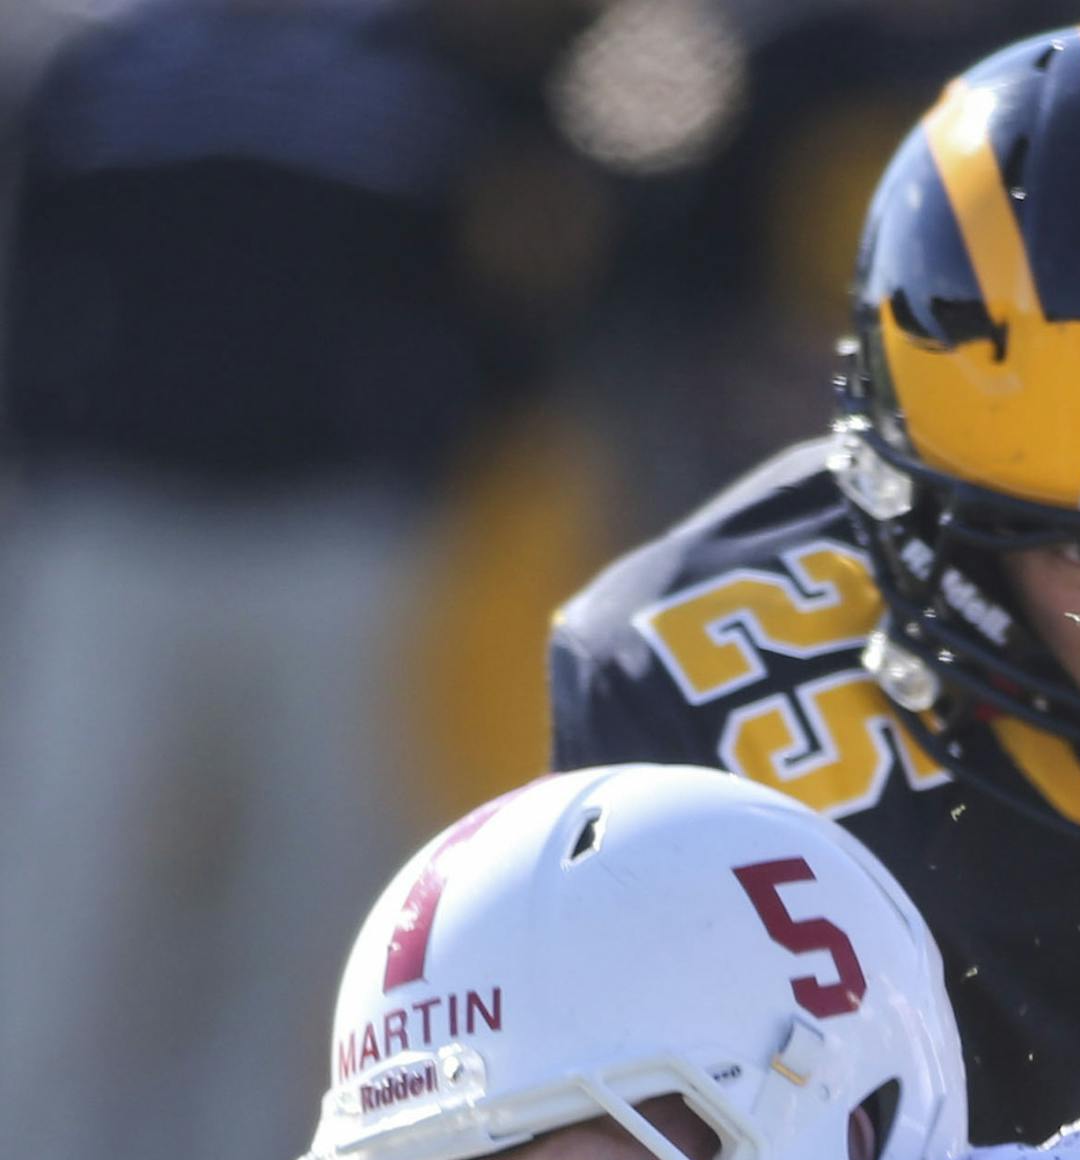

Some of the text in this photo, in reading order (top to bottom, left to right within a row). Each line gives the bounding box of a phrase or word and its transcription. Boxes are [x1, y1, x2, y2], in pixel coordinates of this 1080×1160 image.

[629, 539, 954, 820] 25
[733, 856, 867, 1019] 5
[338, 986, 502, 1084] MARTIN
[360, 1060, 439, 1113] Riddell
